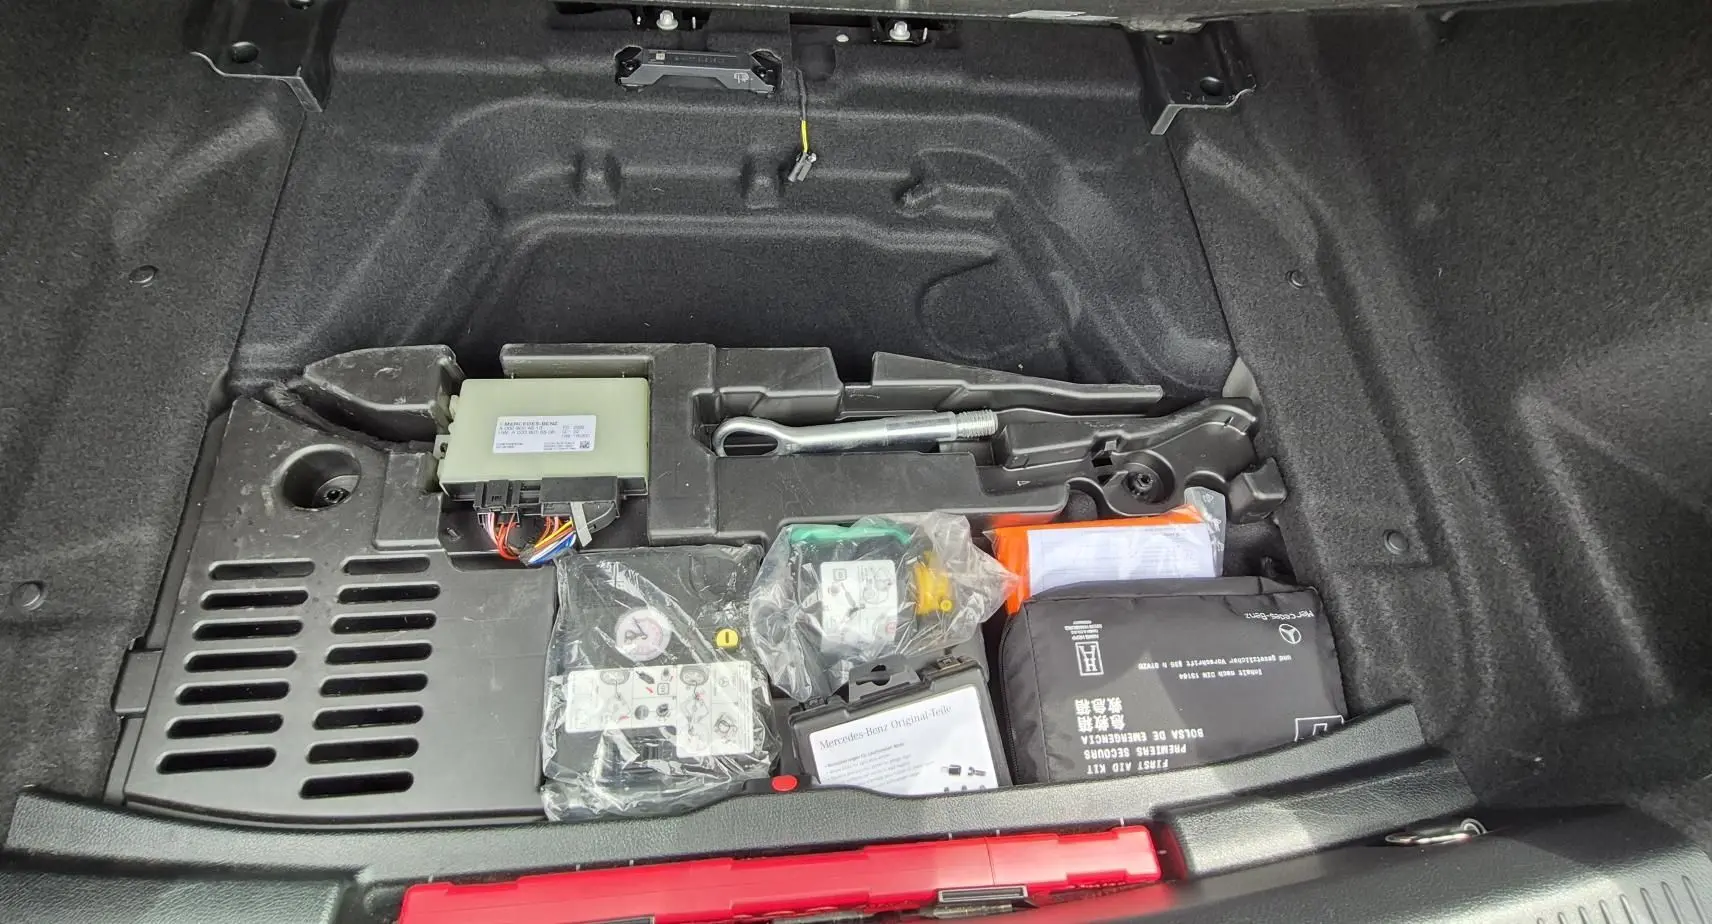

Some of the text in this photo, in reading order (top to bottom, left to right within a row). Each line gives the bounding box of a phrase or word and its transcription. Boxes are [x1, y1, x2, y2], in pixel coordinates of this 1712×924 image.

[1243, 610, 1315, 621] Mercedes-Benz
[1186, 657, 1227, 667] Vorschrift
[1229, 654, 1277, 665] gesetzlicher
[1278, 654, 1292, 663] und
[1202, 670, 1216, 679] DIN
[1218, 669, 1236, 678] nach
[1238, 667, 1263, 677] Inhalt
[1074, 697, 1123, 716] 救急箱
[819, 705, 953, 750] Mercedes-Benz Original-Teile
[1077, 714, 1126, 733] 急救箱
[1080, 727, 1204, 745] BOLSA DE EMERGENCIA
[1083, 743, 1187, 760] PREMIERS SECOURS
[1087, 759, 1169, 775] FIRST AID KIT
